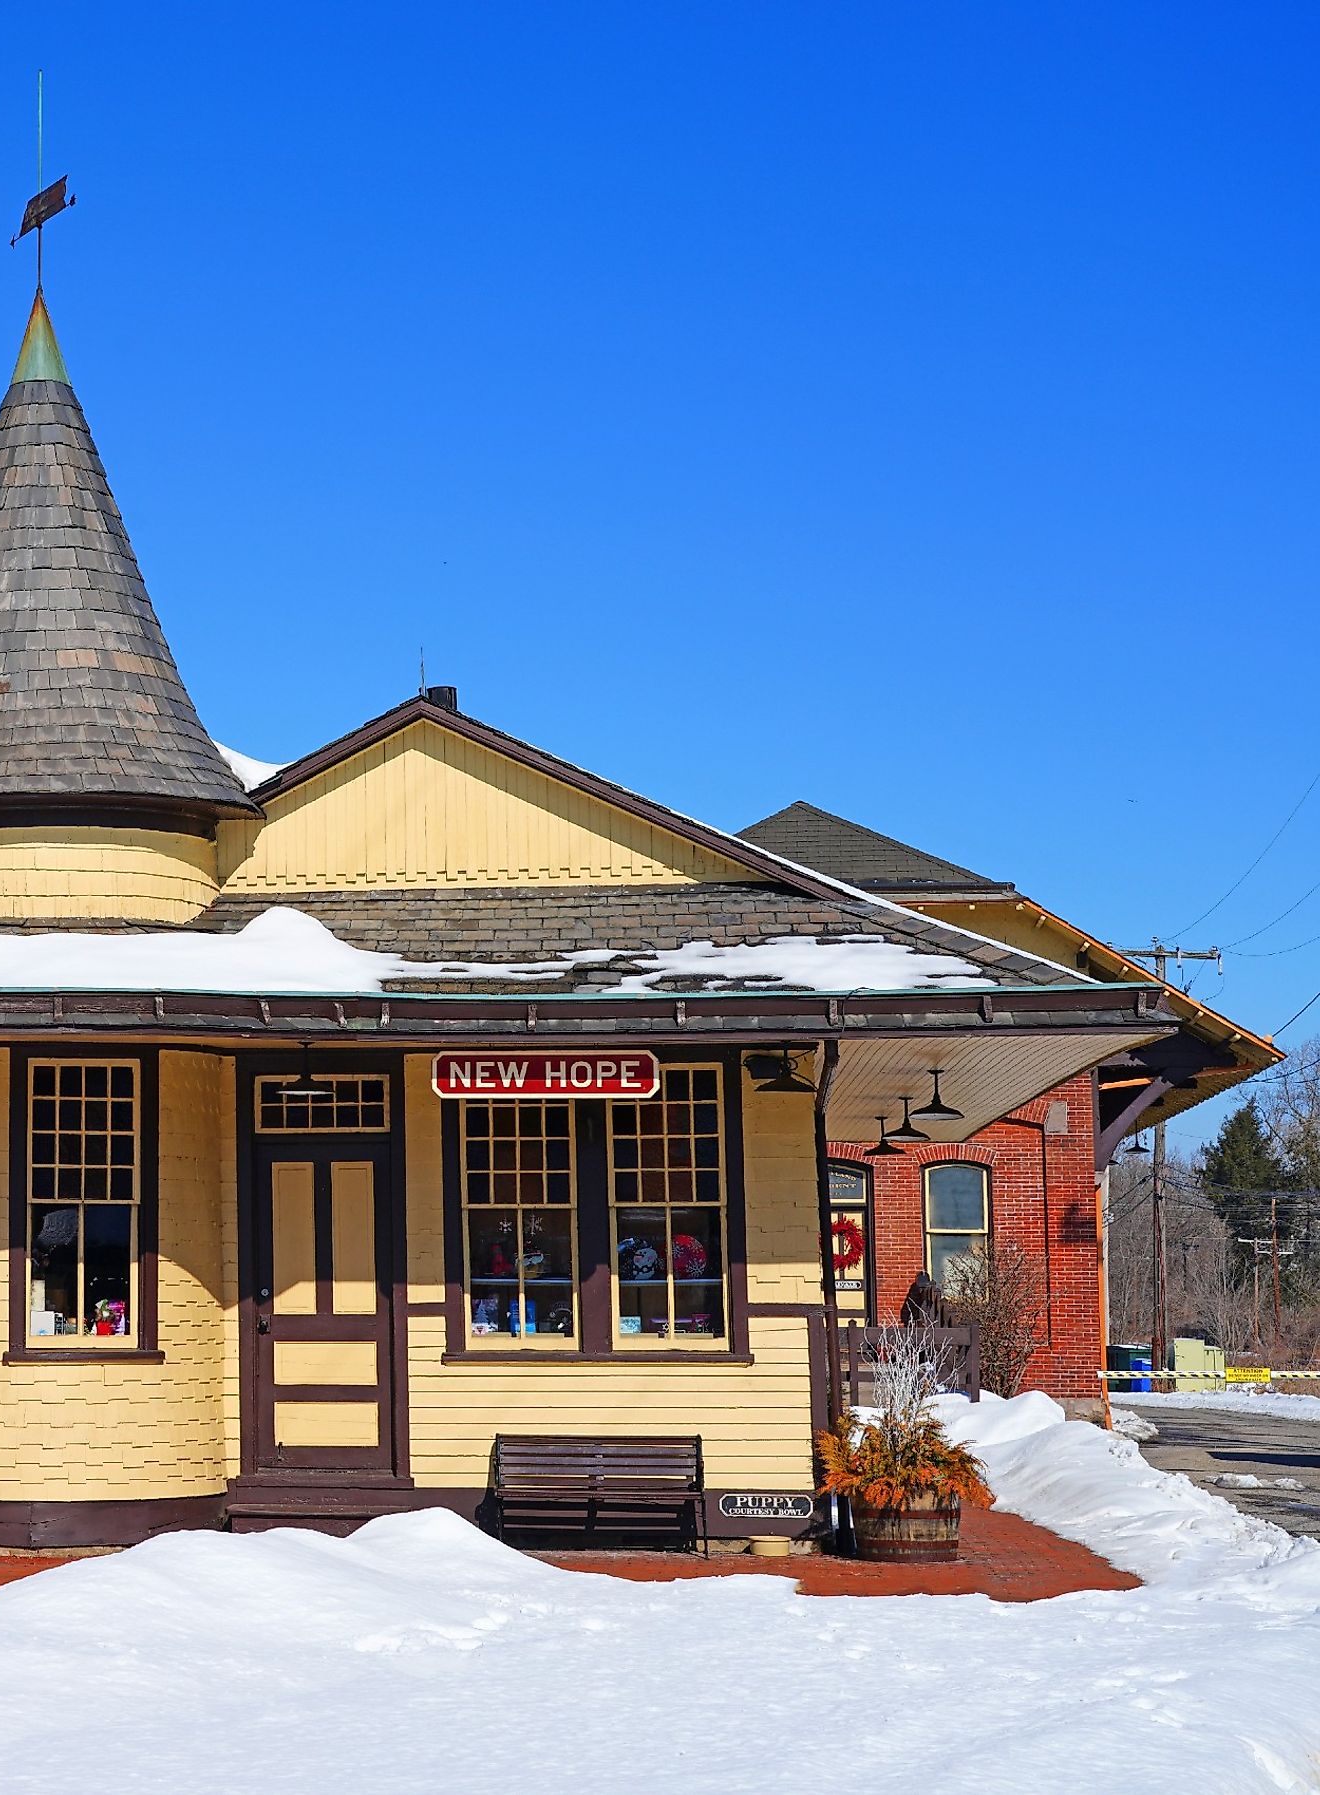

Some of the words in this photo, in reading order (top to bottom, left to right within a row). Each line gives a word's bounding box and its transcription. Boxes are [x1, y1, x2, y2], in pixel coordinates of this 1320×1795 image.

[449, 1061, 529, 1088] NEW
[545, 1061, 642, 1088] HOPE
[736, 1496, 797, 1508] PUPPY
[729, 1508, 776, 1516] COURTESY
[778, 1508, 804, 1516] BOWL
